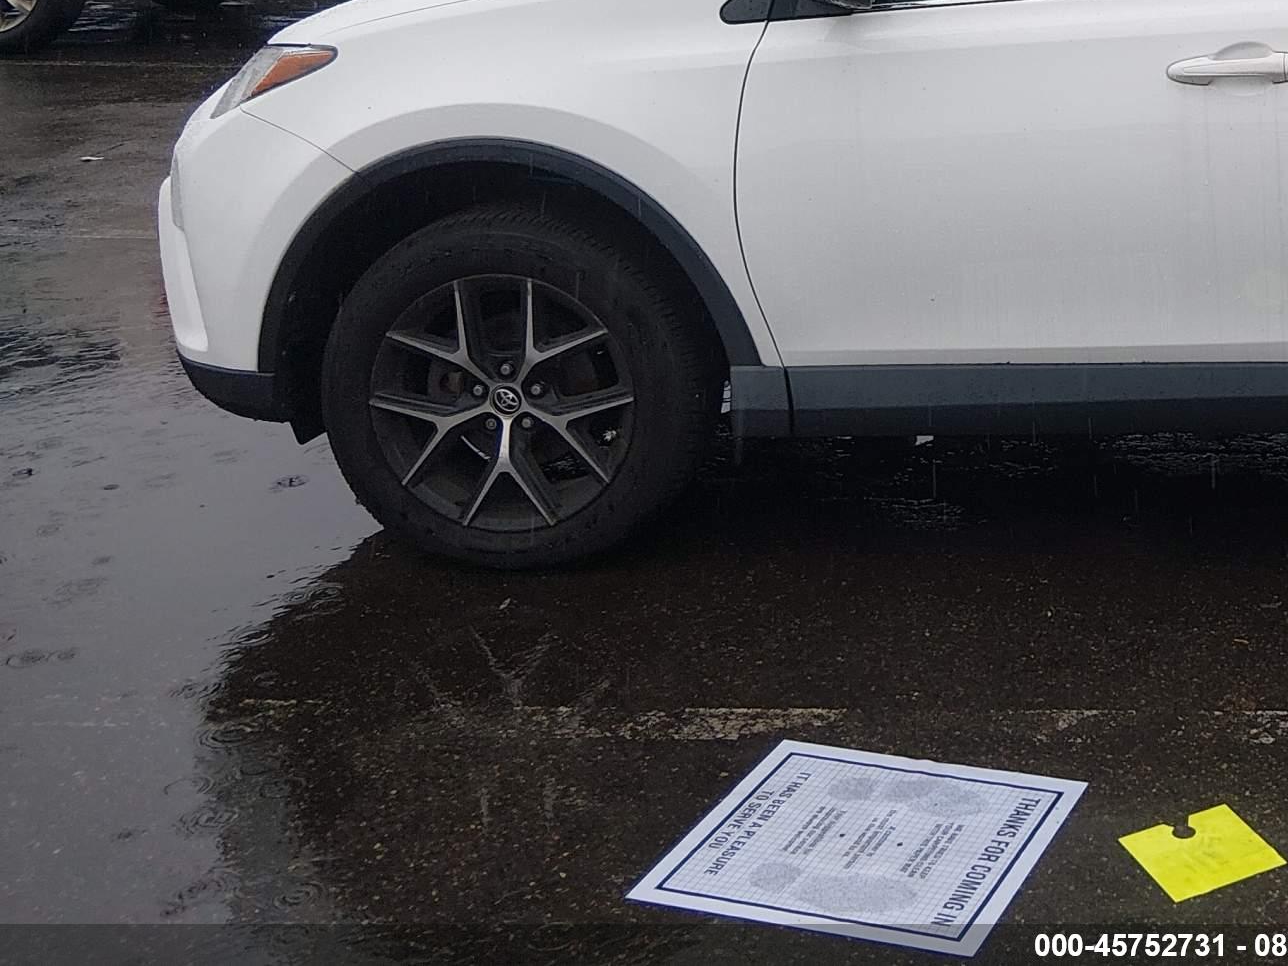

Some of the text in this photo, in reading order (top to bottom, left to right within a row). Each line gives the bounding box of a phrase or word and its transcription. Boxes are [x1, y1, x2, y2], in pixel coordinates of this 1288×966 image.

[778, 781, 803, 799] HAS
[796, 772, 812, 782] IT
[708, 790, 775, 849] TO SERVE YOU
[756, 799, 786, 822] BEEN
[704, 830, 756, 876] PLEASURE
[931, 798, 1041, 927] THANKS FOR COMING IN
